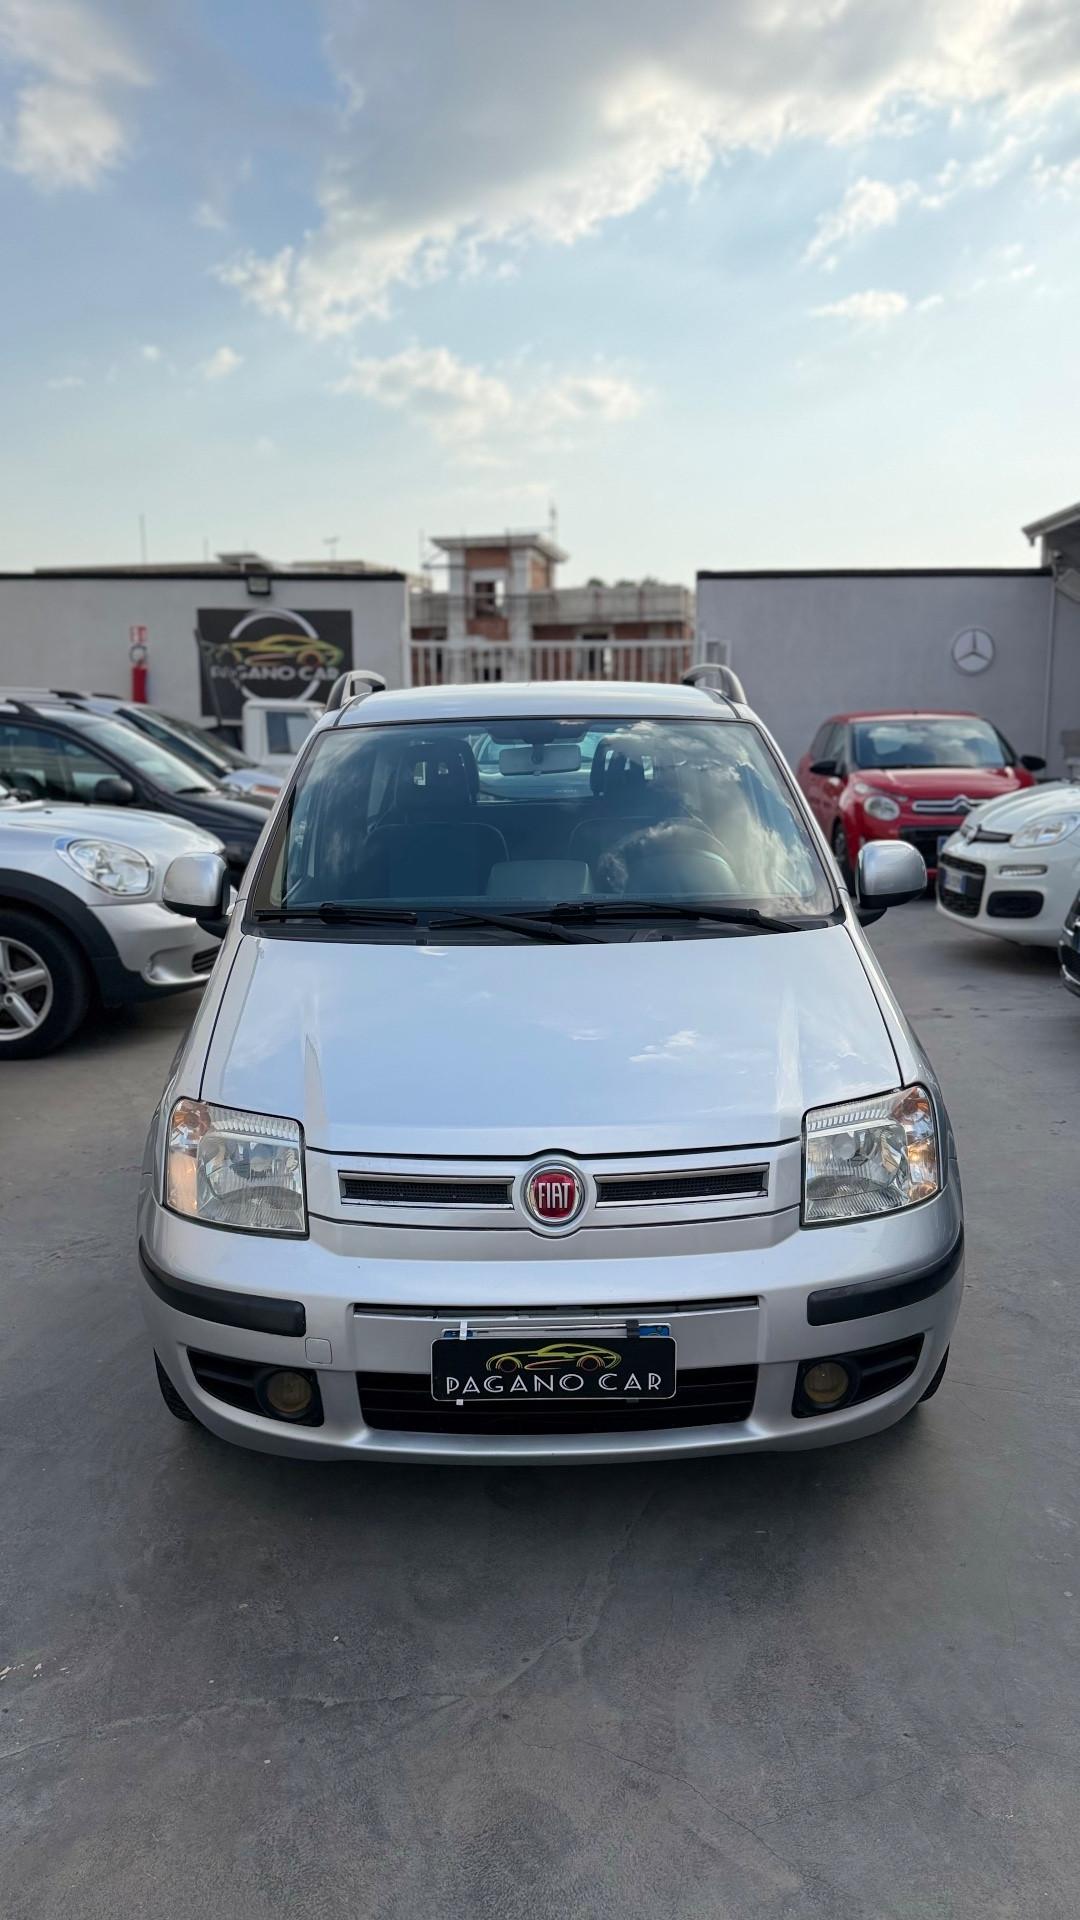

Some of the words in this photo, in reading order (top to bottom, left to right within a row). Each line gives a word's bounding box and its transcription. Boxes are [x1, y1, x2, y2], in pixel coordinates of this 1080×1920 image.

[299, 665, 341, 681] CAR
[538, 1182, 571, 1209] FIAT
[446, 1374, 584, 1394] PAGANO
[598, 1373, 662, 1391] CAR
